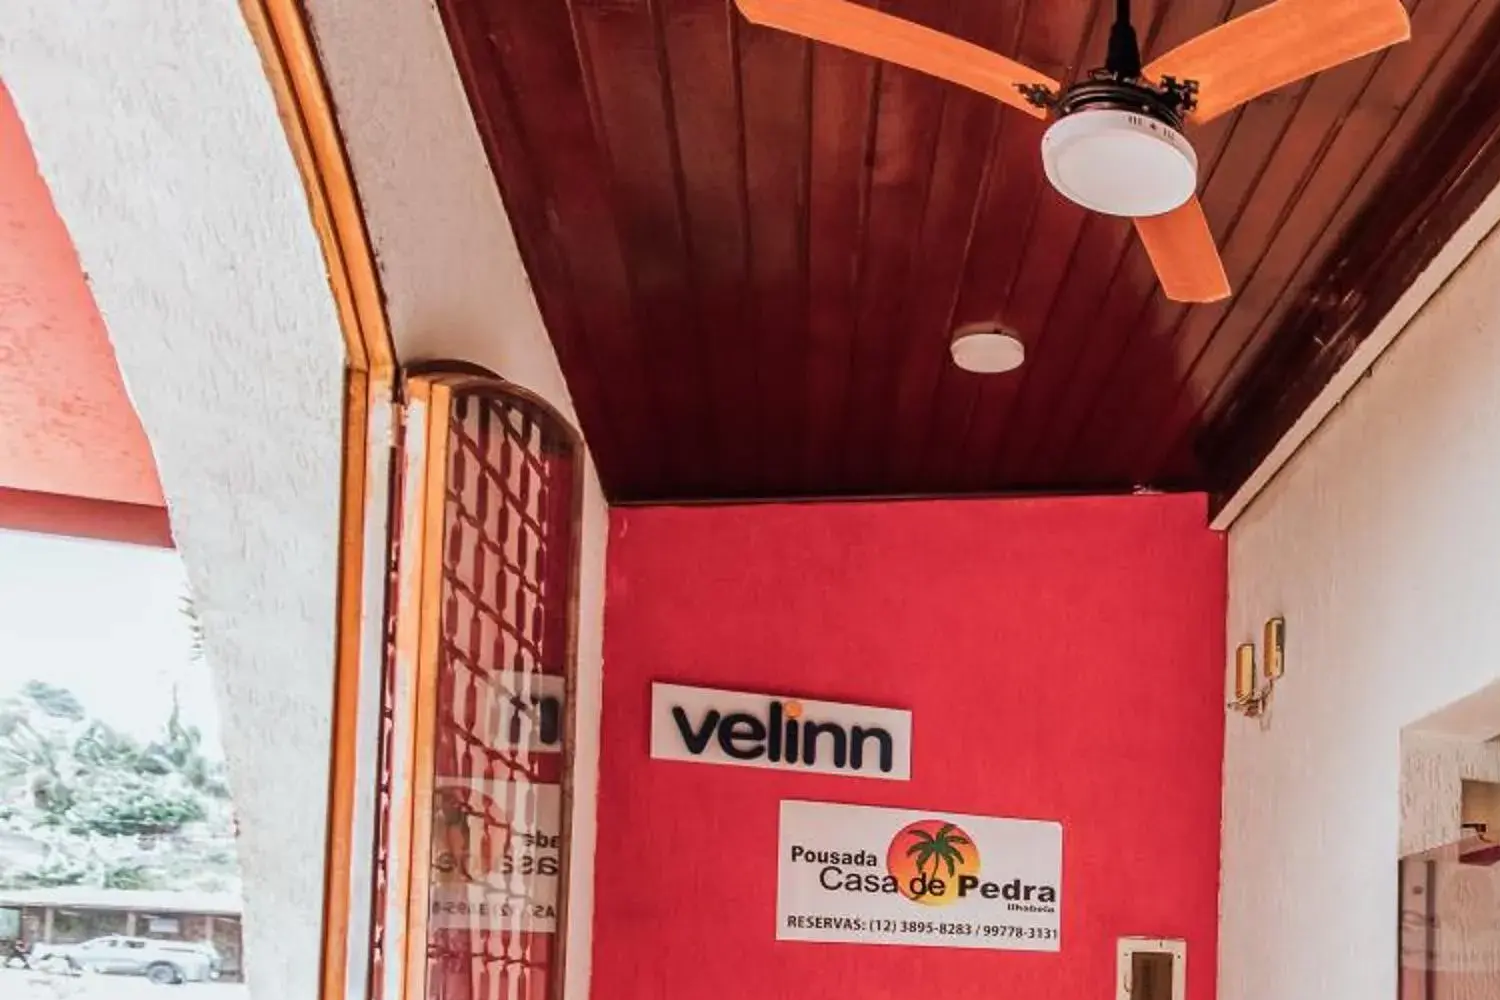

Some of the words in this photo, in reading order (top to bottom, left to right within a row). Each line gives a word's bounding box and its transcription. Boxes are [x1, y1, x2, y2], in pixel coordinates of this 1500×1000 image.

[671, 701, 893, 773] velinn
[791, 845, 878, 867] Pousada
[819, 865, 899, 894] Casa
[909, 872, 945, 895] de
[957, 874, 1057, 903] Pedra
[1007, 903, 1055, 913] Ilhabela
[787, 915, 866, 931] RESERVAS:
[869, 919, 897, 934] (12)
[900, 920, 972, 936] 3895-8283
[983, 925, 1057, 940] 99778-3131
